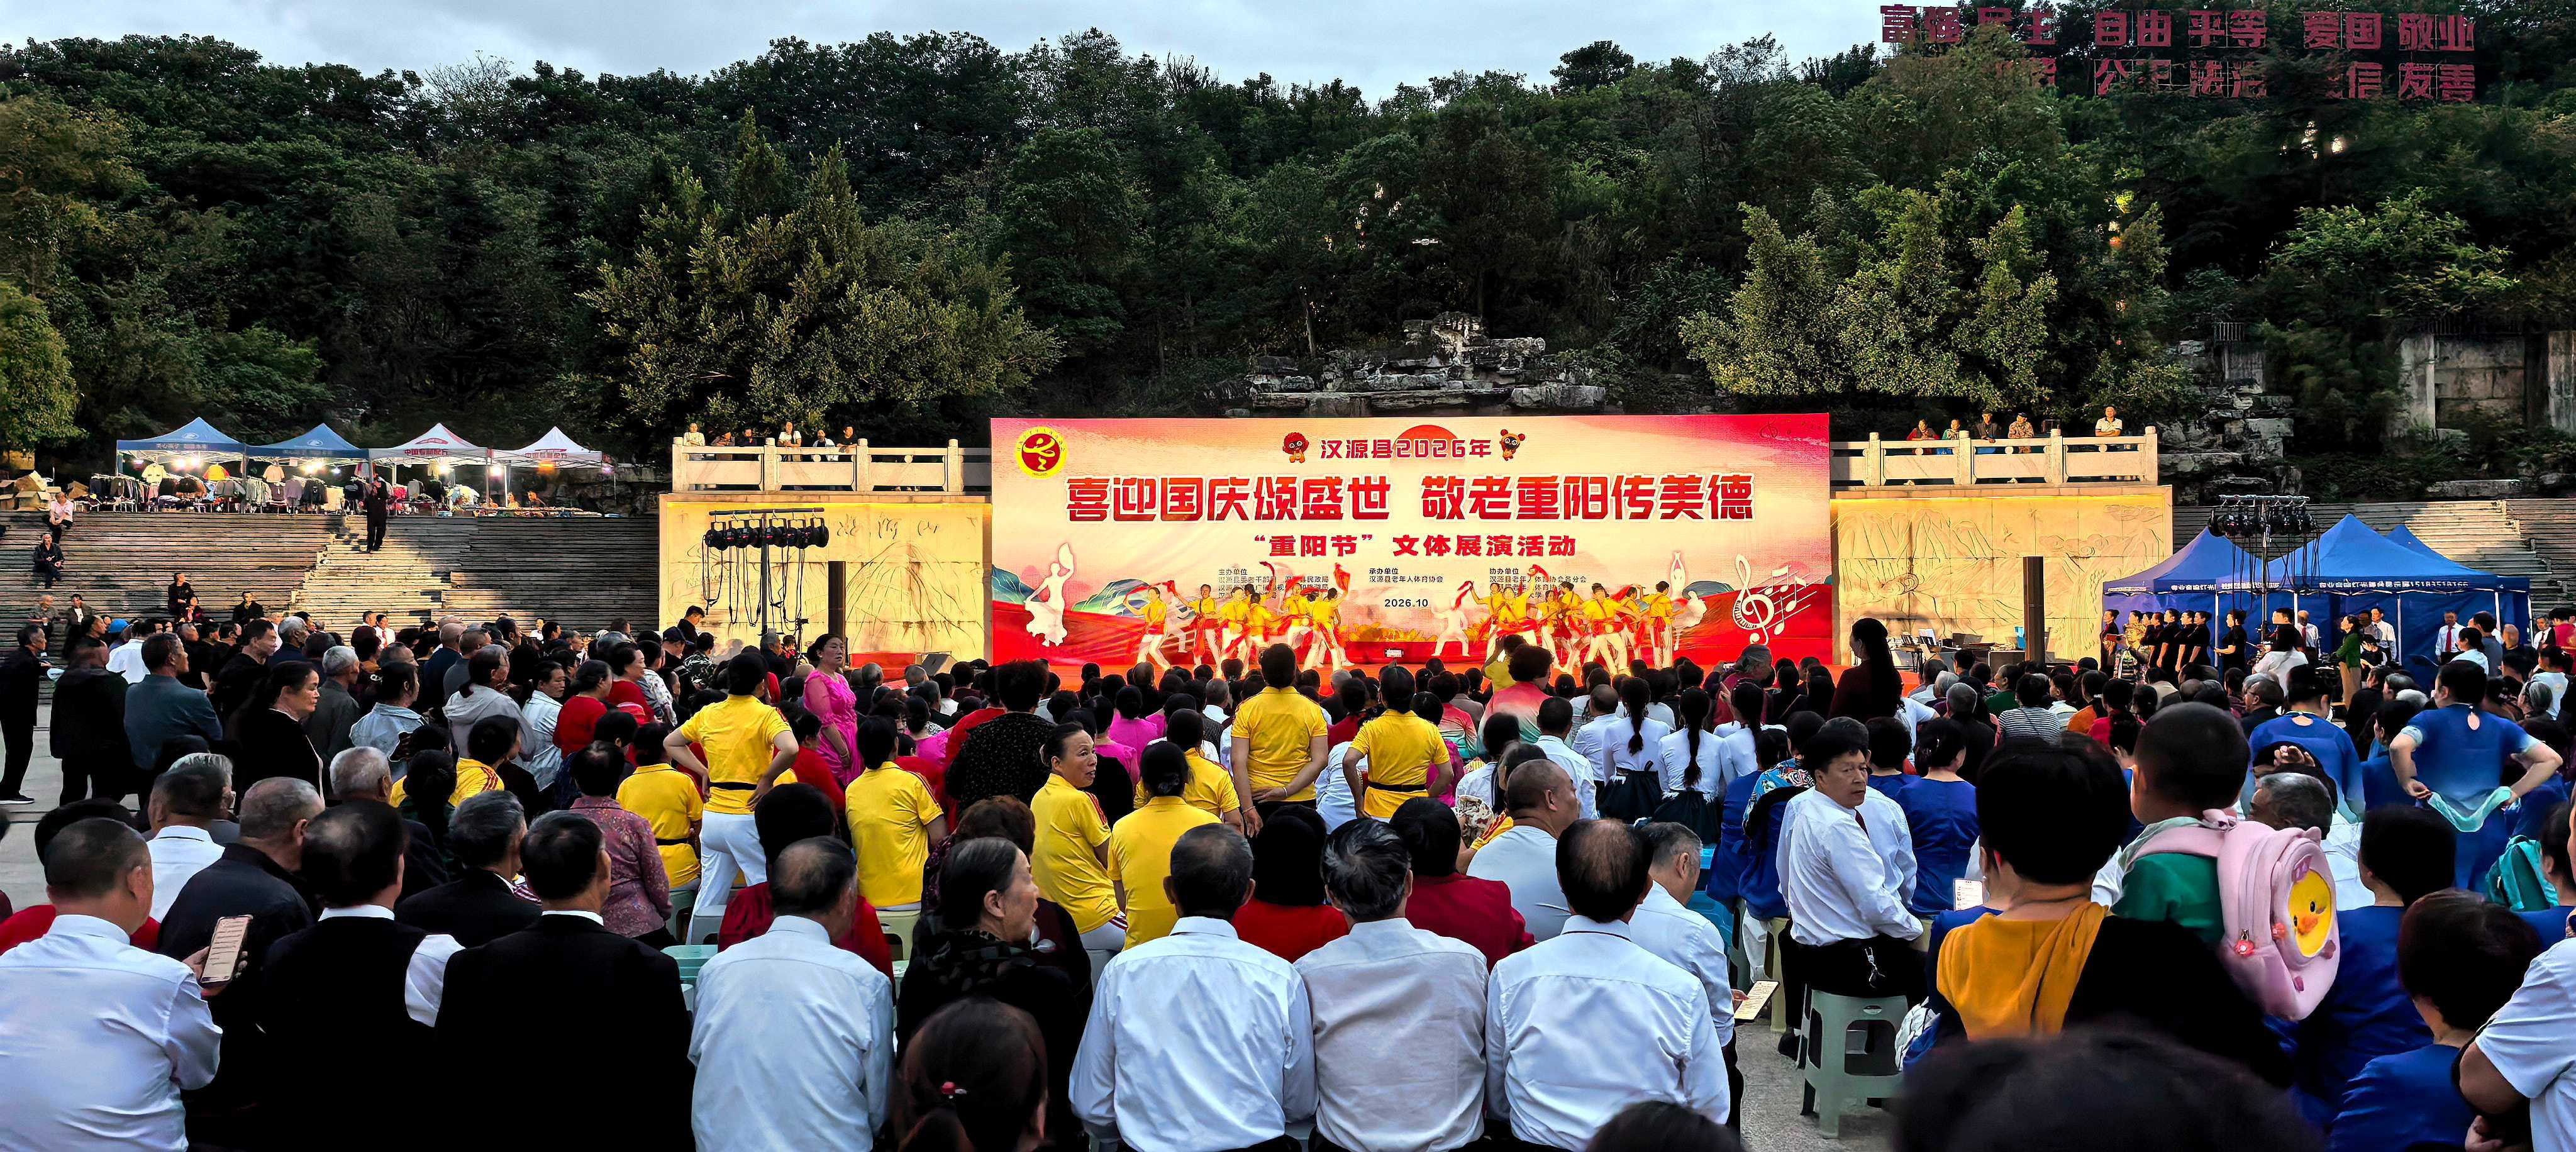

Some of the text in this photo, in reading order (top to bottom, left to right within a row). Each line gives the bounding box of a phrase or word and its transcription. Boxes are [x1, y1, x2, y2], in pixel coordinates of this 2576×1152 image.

[2095, 9, 2171, 47] 自由
[2189, 10, 2267, 47] 平等
[2304, 11, 2383, 50] 爱国
[2399, 13, 2475, 51] 敬业
[2399, 62, 2475, 101] 友善
[1320, 438, 1492, 460] 汉源县2026年
[1066, 474, 1754, 521] 喜迎国庆颂盛世 敬老重阳传美德
[1384, 599, 1429, 607] 2026.10
